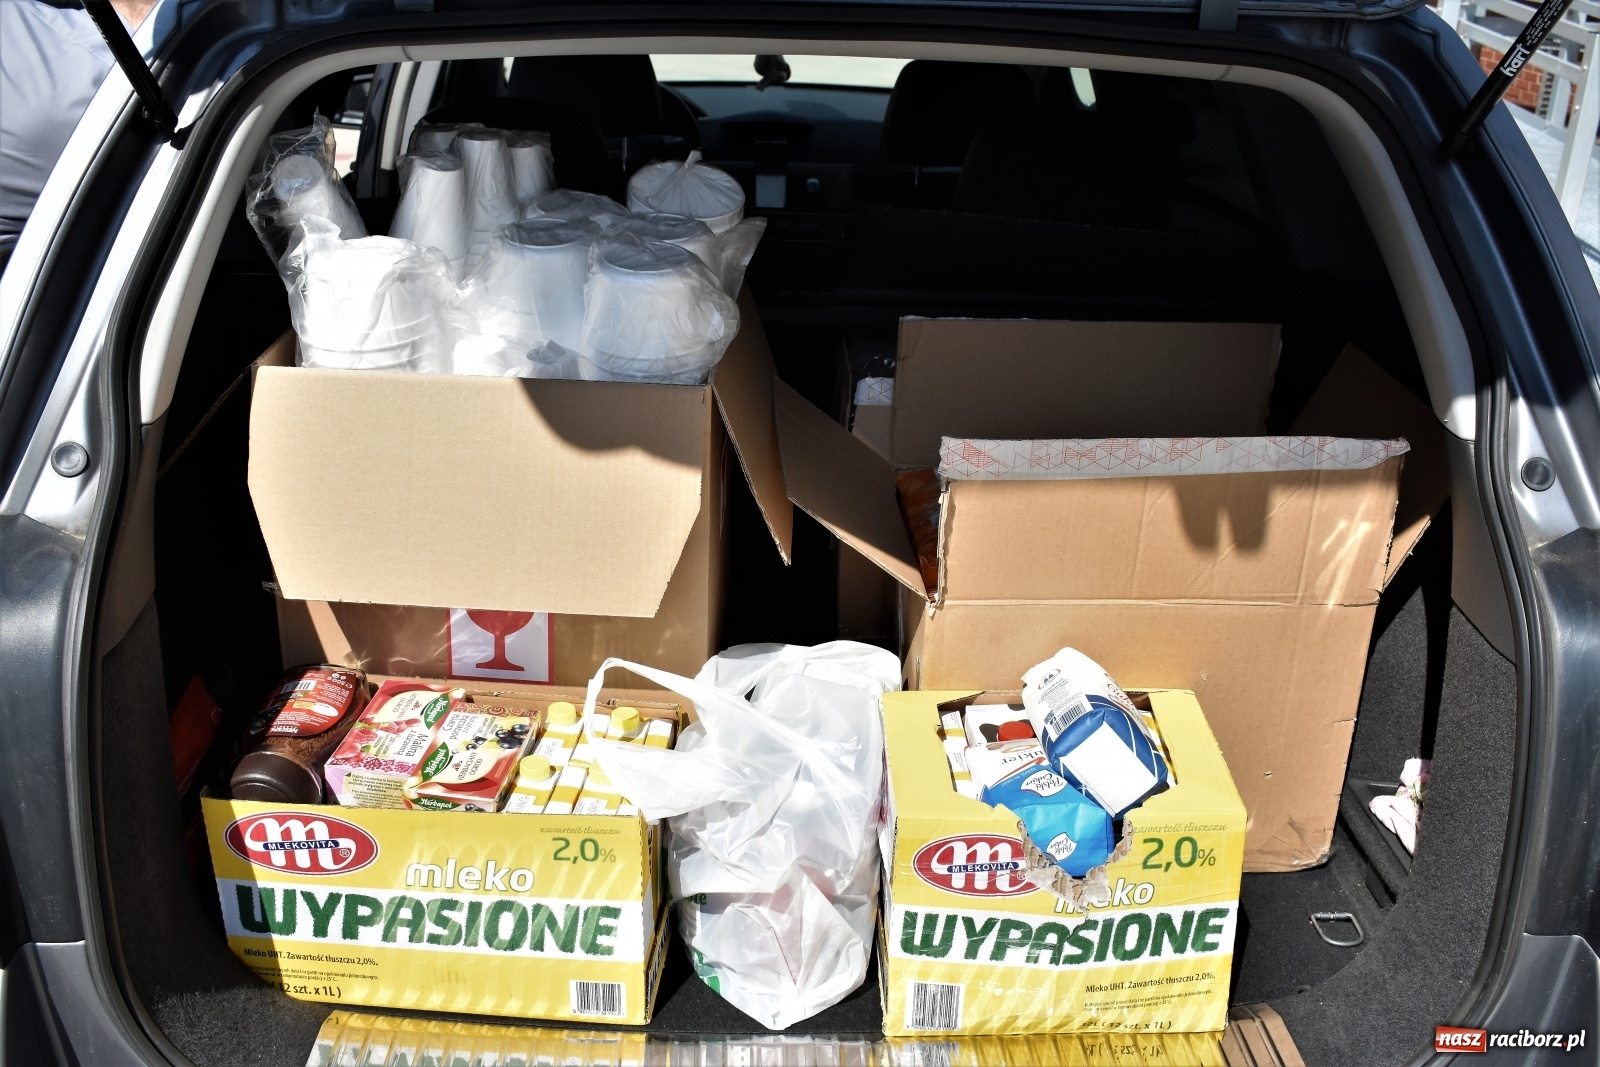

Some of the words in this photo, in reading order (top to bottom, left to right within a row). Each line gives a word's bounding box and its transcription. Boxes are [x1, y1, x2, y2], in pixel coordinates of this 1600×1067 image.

[1500, 43, 1530, 77] hart
[442, 713, 461, 732] Czarna
[449, 714, 470, 740] porzeczka
[405, 733, 429, 758] Malina
[423, 748, 447, 778] Herbapol
[1001, 750, 1044, 765] ukier
[1025, 772, 1053, 787] Cukier
[1035, 776, 1064, 791] Polski
[420, 798, 453, 809] Herbapol
[1133, 822, 1183, 834] zawartość
[1183, 821, 1229, 832] tłuszczu
[267, 840, 335, 850] MLEKOVITA
[552, 837, 617, 865] 2,0%
[1141, 836, 1217, 873] 2,0%
[405, 858, 535, 893] mleko
[951, 861, 1015, 874] MLEKOVITA
[235, 884, 622, 956] WYPASIONE
[900, 907, 1230, 966] WYPASIONE
[243, 947, 267, 958] Mleko
[267, 950, 286, 960] UHT.
[286, 951, 325, 962] Zawartość
[325, 954, 356, 965] tłuszczu
[293, 984, 312, 995] szt.
[1085, 984, 1109, 994] Mleko
[1109, 981, 1127, 991] UHT.
[1128, 979, 1165, 990] Zawartość
[1165, 975, 1194, 985] tłuszczu
